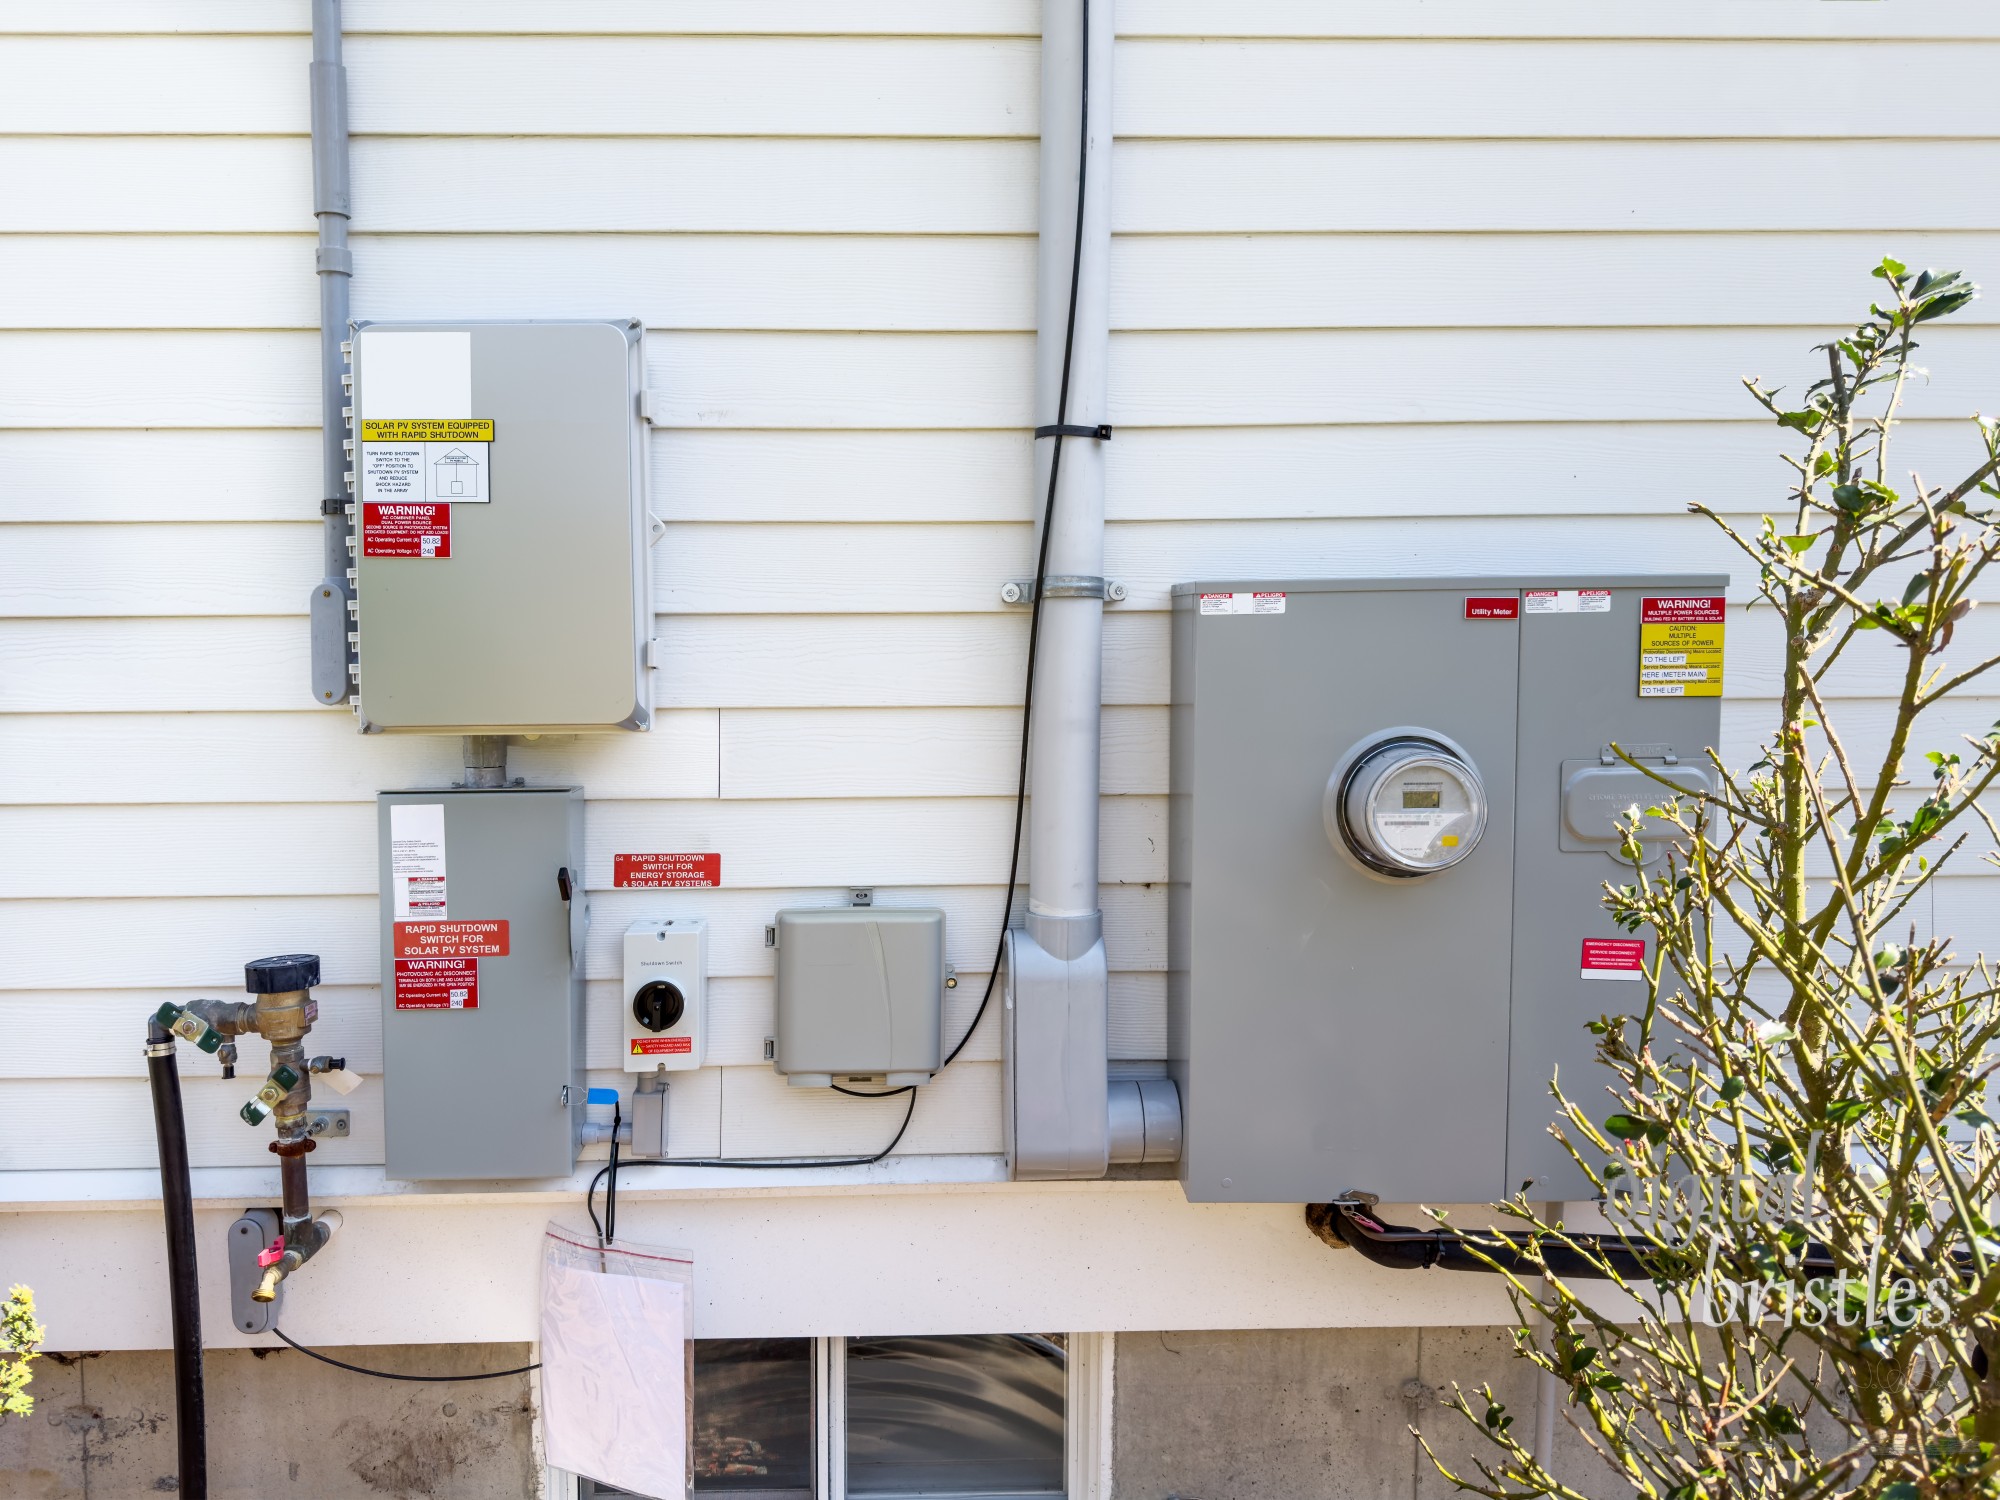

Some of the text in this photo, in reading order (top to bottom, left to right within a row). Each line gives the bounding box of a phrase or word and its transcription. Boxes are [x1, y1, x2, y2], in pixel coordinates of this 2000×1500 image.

[378, 506, 435, 515] WARNING!
[1658, 600, 1710, 608] WARNING!
[440, 924, 497, 932] SHUTDOWN
[460, 945, 499, 953] SYSTEM
[408, 960, 465, 969] WARNING!
